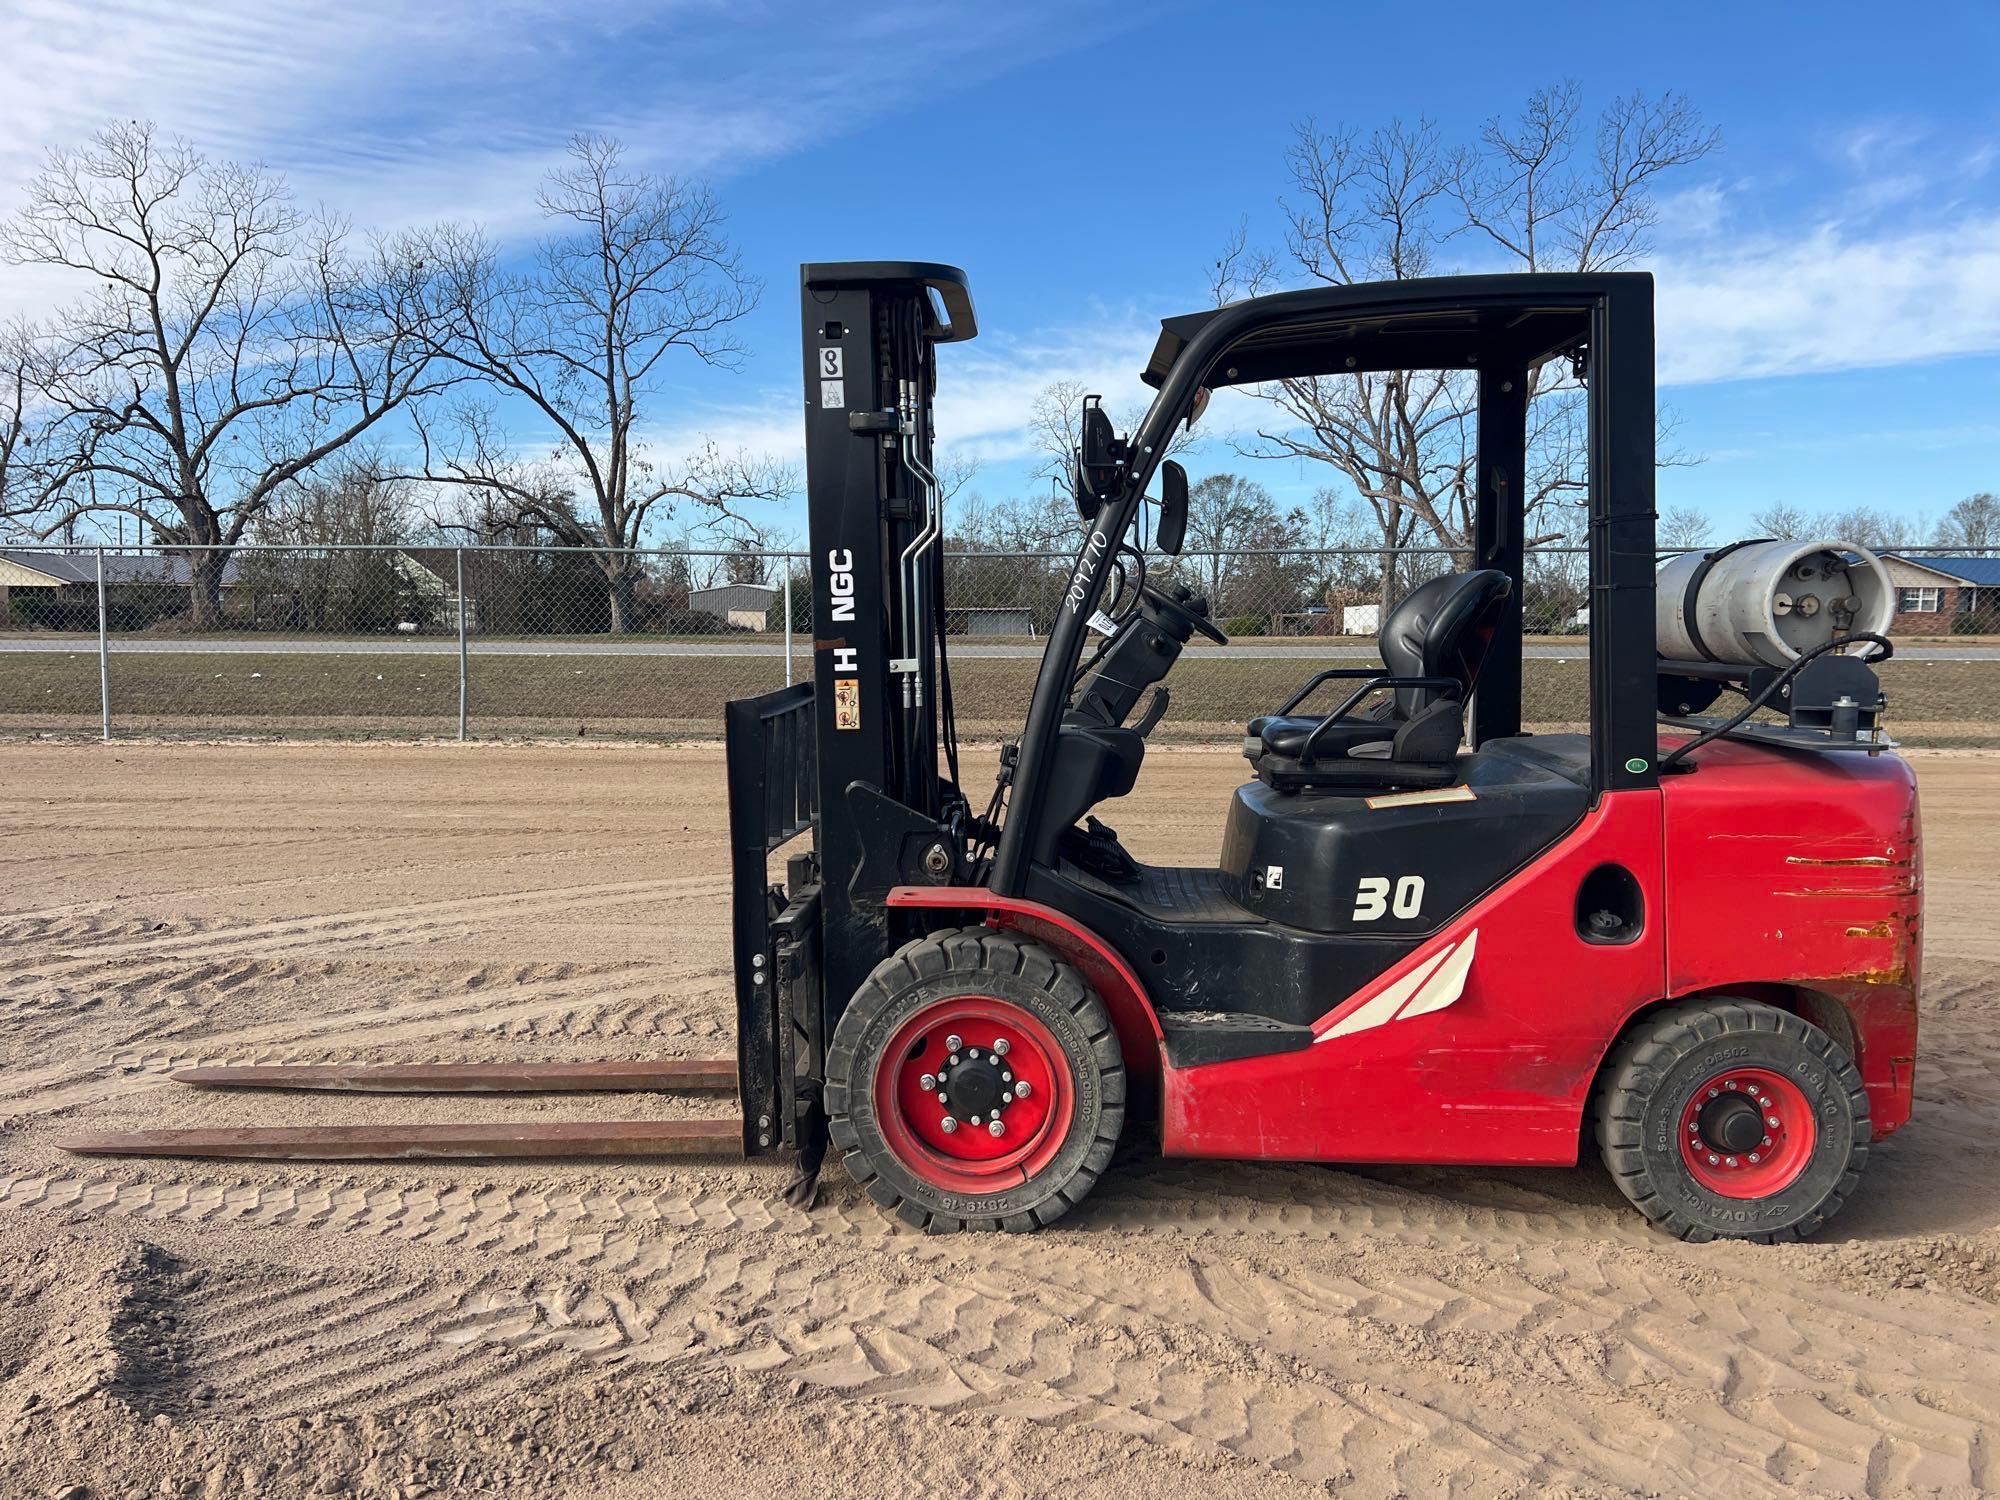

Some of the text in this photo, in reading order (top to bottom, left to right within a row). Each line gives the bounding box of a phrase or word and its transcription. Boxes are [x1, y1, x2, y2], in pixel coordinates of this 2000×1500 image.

[1065, 530, 1107, 614] 209270
[828, 548, 858, 672] H NGC
[1351, 875, 1425, 922] 30
[865, 985, 931, 1052] ADVANCE
[1029, 996, 1081, 1055] Solid-Super
[1076, 1052, 1091, 1080] Lug
[1704, 1046, 1750, 1067] OB502
[1079, 1079, 1093, 1122] OB502
[1681, 1190, 1760, 1223] ADVANCE
